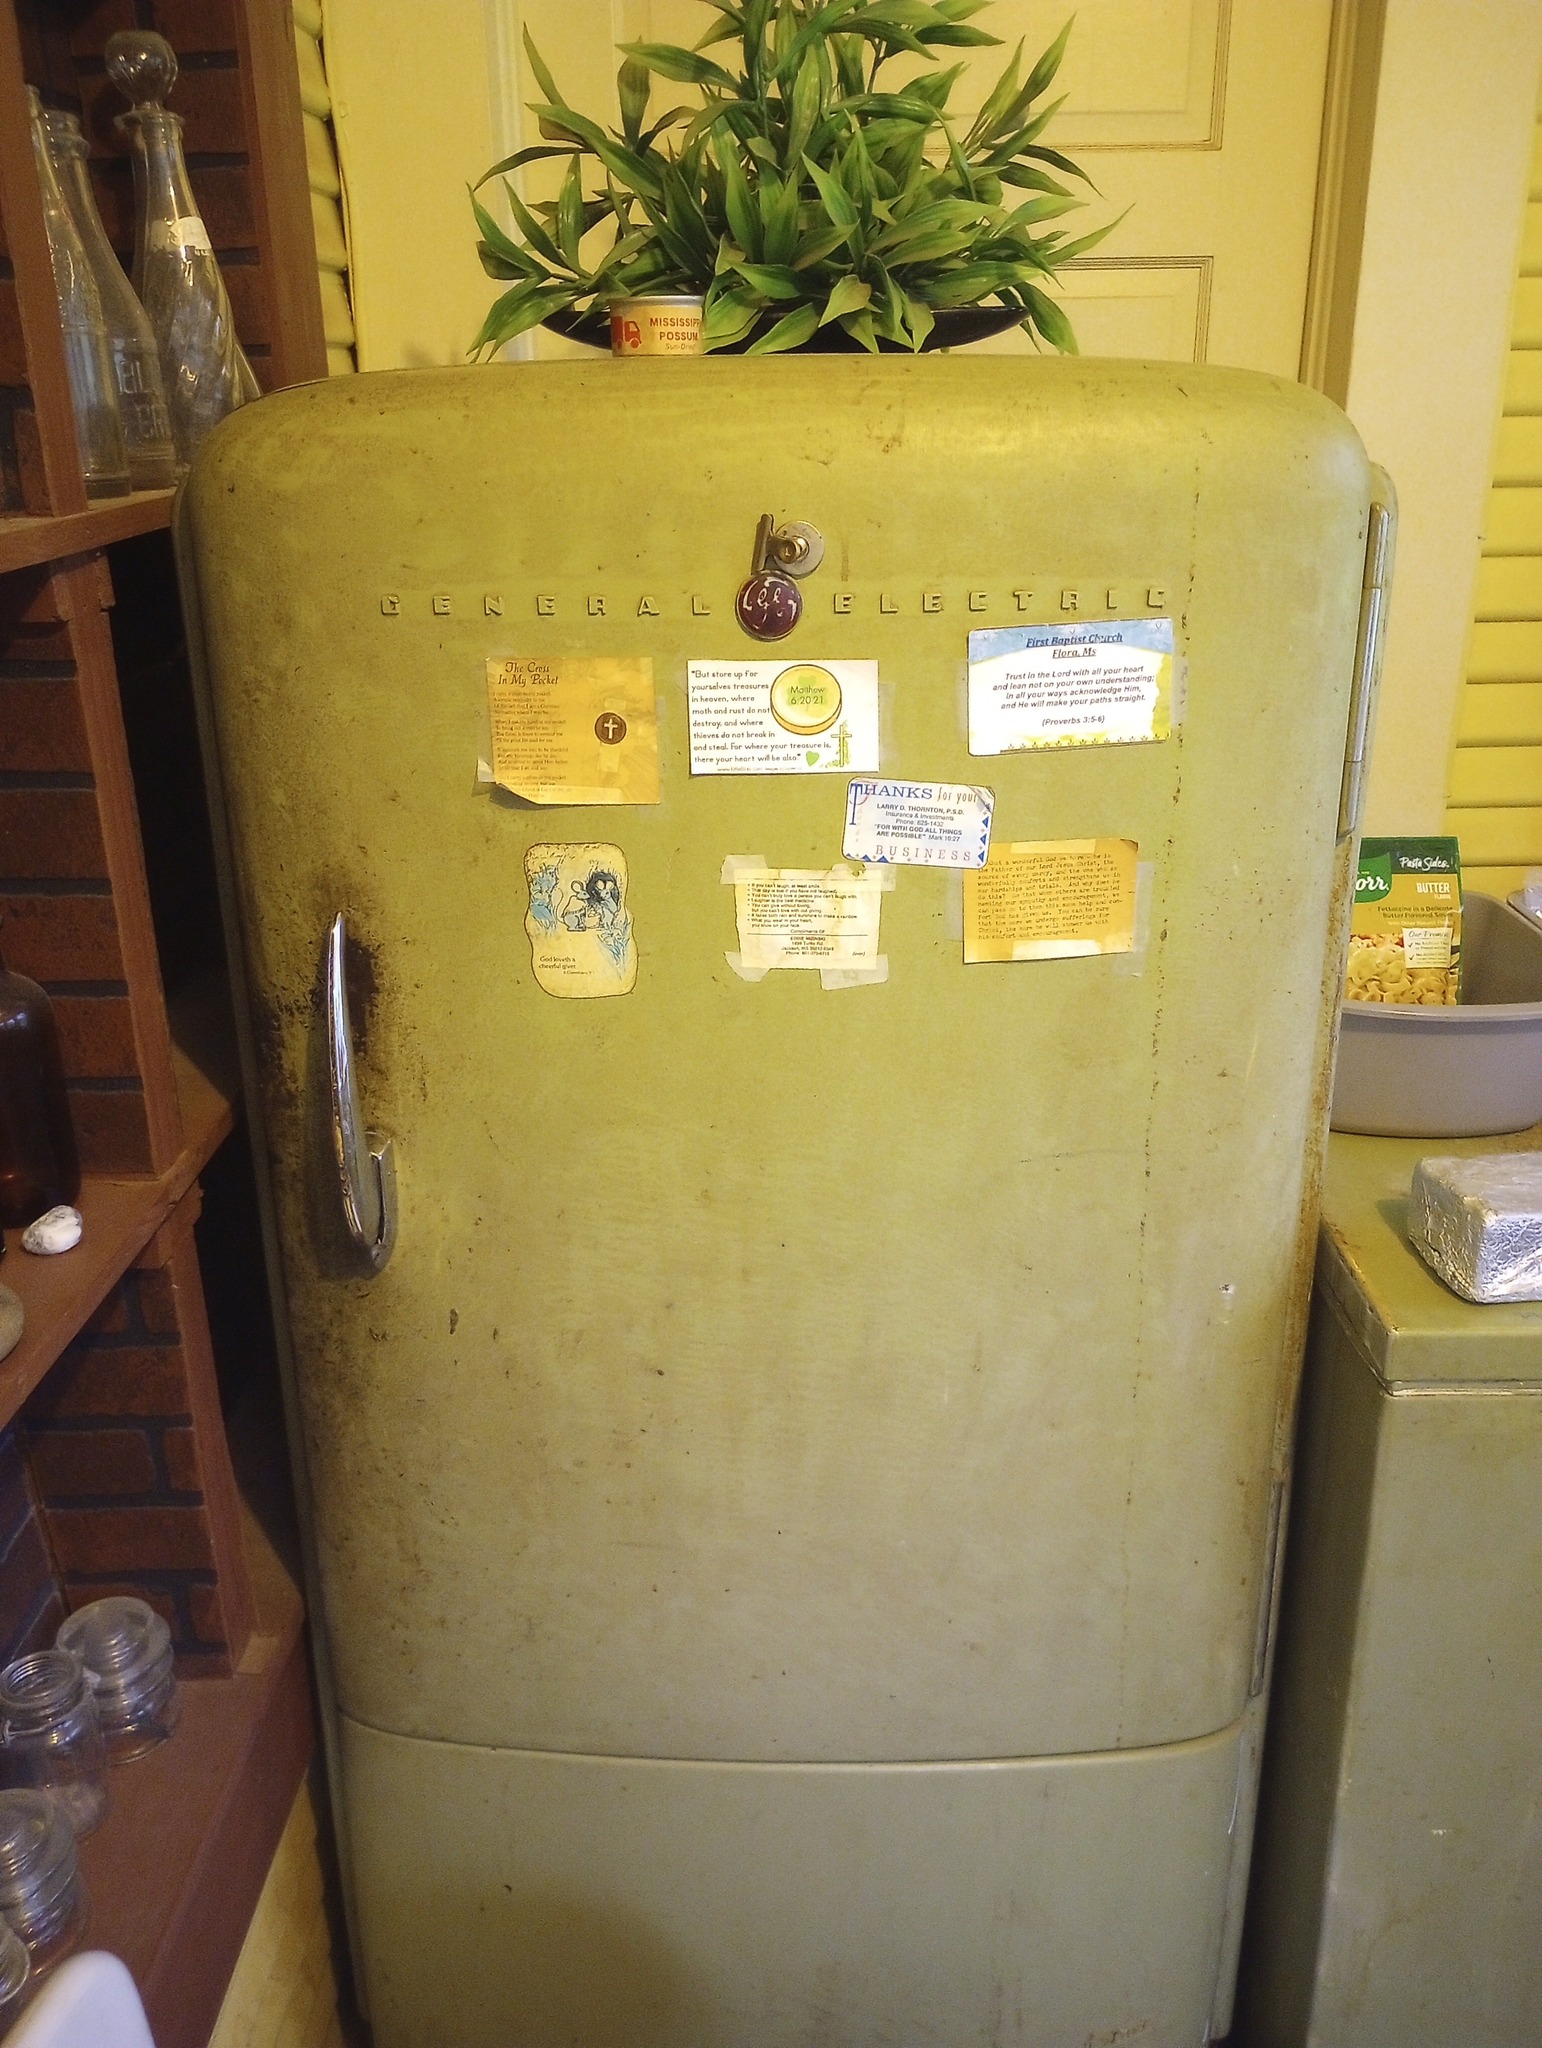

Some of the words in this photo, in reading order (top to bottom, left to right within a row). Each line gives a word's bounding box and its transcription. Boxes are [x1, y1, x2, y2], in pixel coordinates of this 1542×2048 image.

[649, 317, 700, 327] MISSISSIPP
[659, 332, 698, 341] POSSUM
[380, 594, 711, 617] GENERAL
[833, 589, 1166, 614] ELECTRIC
[1026, 638, 1049, 648] First
[1051, 636, 1086, 646] Baptist
[1088, 633, 1123, 644] Church
[1083, 647, 1097, 657] Ms
[505, 662, 523, 672] The
[527, 661, 549, 673] Cross
[734, 672, 743, 680] up
[1052, 670, 1071, 678] Lord
[1103, 668, 1121, 676] your
[498, 674, 507, 684] In
[510, 673, 526, 688] My
[531, 673, 558, 685] Pocket
[1056, 680, 1074, 689] your
[1095, 675, 1155, 685] understanding;
[692, 682, 730, 692] yourselves
[791, 686, 825, 694] Matthew
[1027, 691, 1045, 700] your
[1047, 690, 1068, 698] ways
[1070, 686, 1122, 696] acknowledge
[1124, 685, 1141, 693] Him,
[1001, 701, 1016, 709] and
[1046, 699, 1068, 707] make
[1069, 698, 1088, 707] your
[1090, 696, 1112, 705] paths
[1114, 694, 1146, 703] straight.
[1041, 716, 1081, 727] (Proverbs
[1083, 715, 1105, 724] 3:5-6)
[731, 742, 743, 750] For
[771, 744, 787, 752] your
[716, 757, 733, 765] your
[937, 787, 952, 802] for
[957, 792, 977, 804] your
[908, 806, 945, 814] THORNTON,
[920, 813, 954, 821] Investments
[925, 826, 937, 834] ALL
[875, 845, 971, 861] BUSINESS
[1399, 856, 1422, 869] Pasta
[1422, 856, 1448, 871] Sides
[1355, 876, 1388, 891] orr
[1416, 882, 1450, 893] BUTTER
